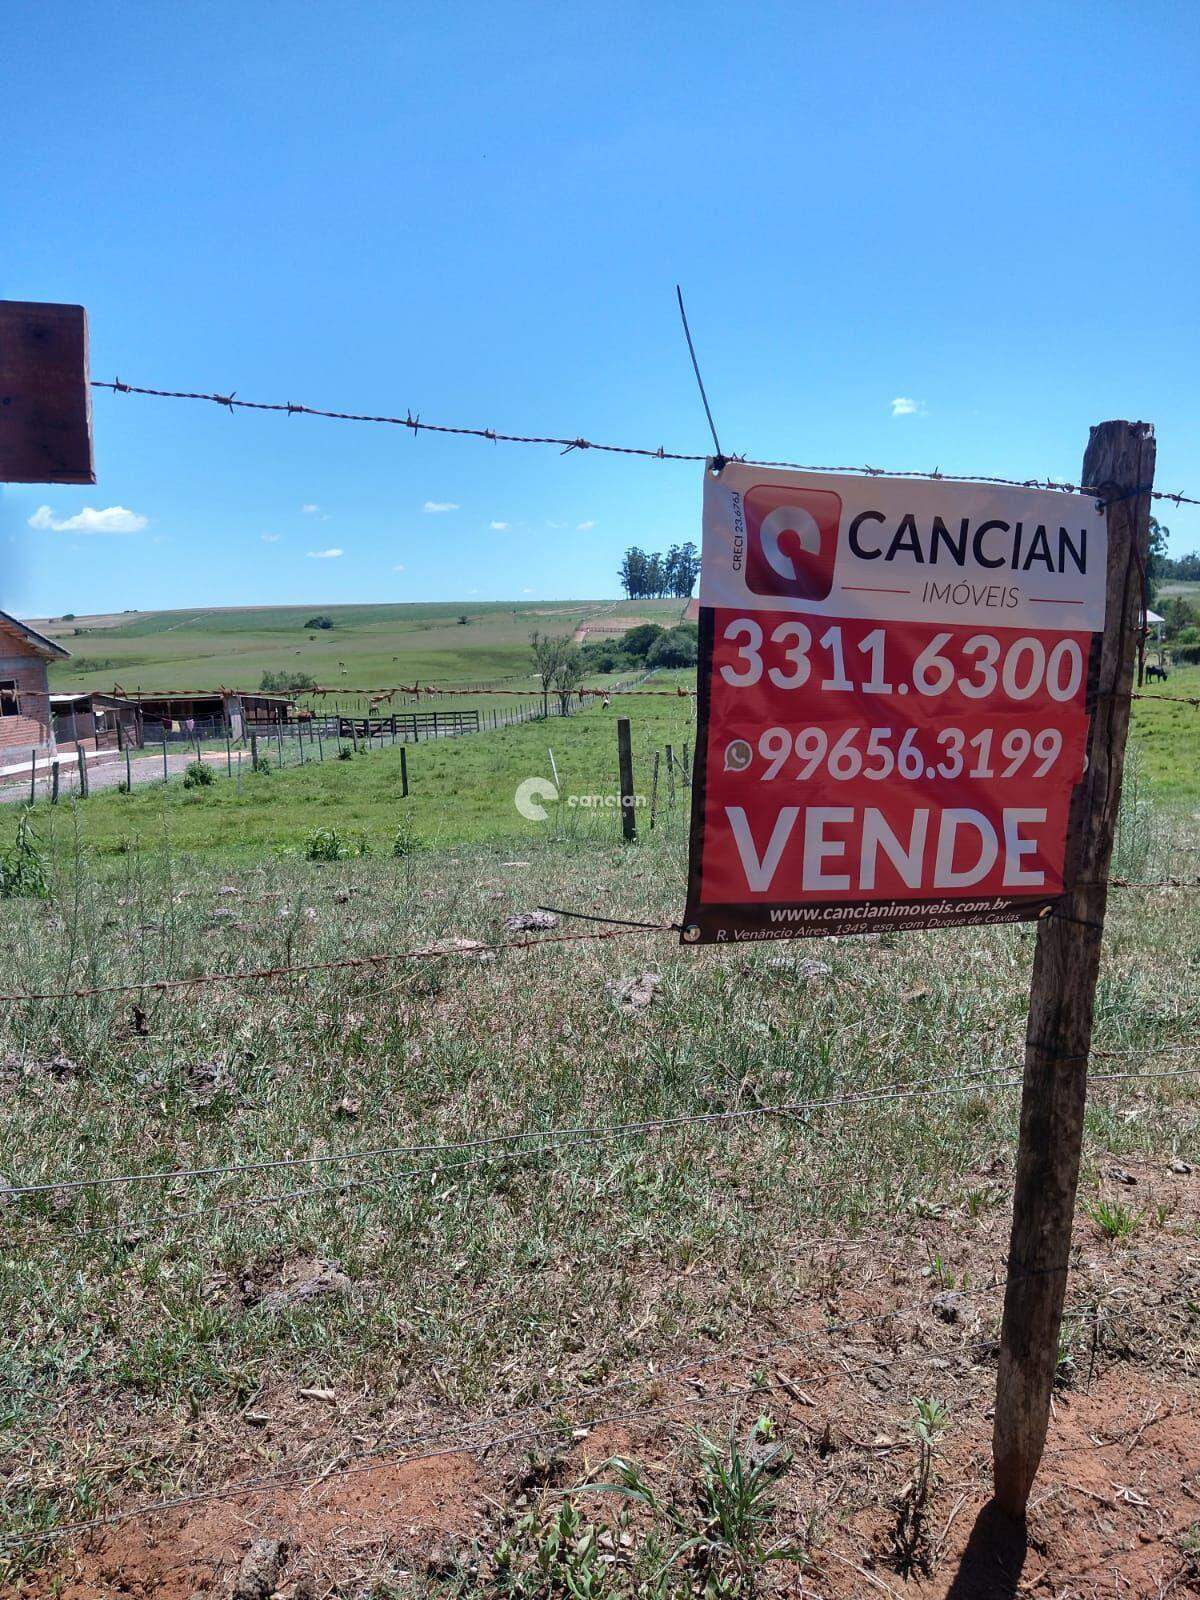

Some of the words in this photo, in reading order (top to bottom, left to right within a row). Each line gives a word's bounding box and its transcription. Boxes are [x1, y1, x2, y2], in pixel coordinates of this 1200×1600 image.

[732, 536, 743, 571] CRECI
[848, 510, 1087, 574] CANCIAN
[922, 580, 1020, 608] IMÓVEIS
[719, 618, 1083, 702] 3311.6300
[758, 727, 1063, 781] 99656.3199
[725, 806, 1048, 892] VENDE
[716, 929, 729, 941] R.
[734, 929, 793, 941] Venâncio
[899, 920, 925, 930] com
[927, 918, 968, 929] Duque
[968, 915, 983, 924] de
[985, 913, 1020, 923] Caxias
[770, 897, 1012, 922] www.cancianimoveis.com.br
